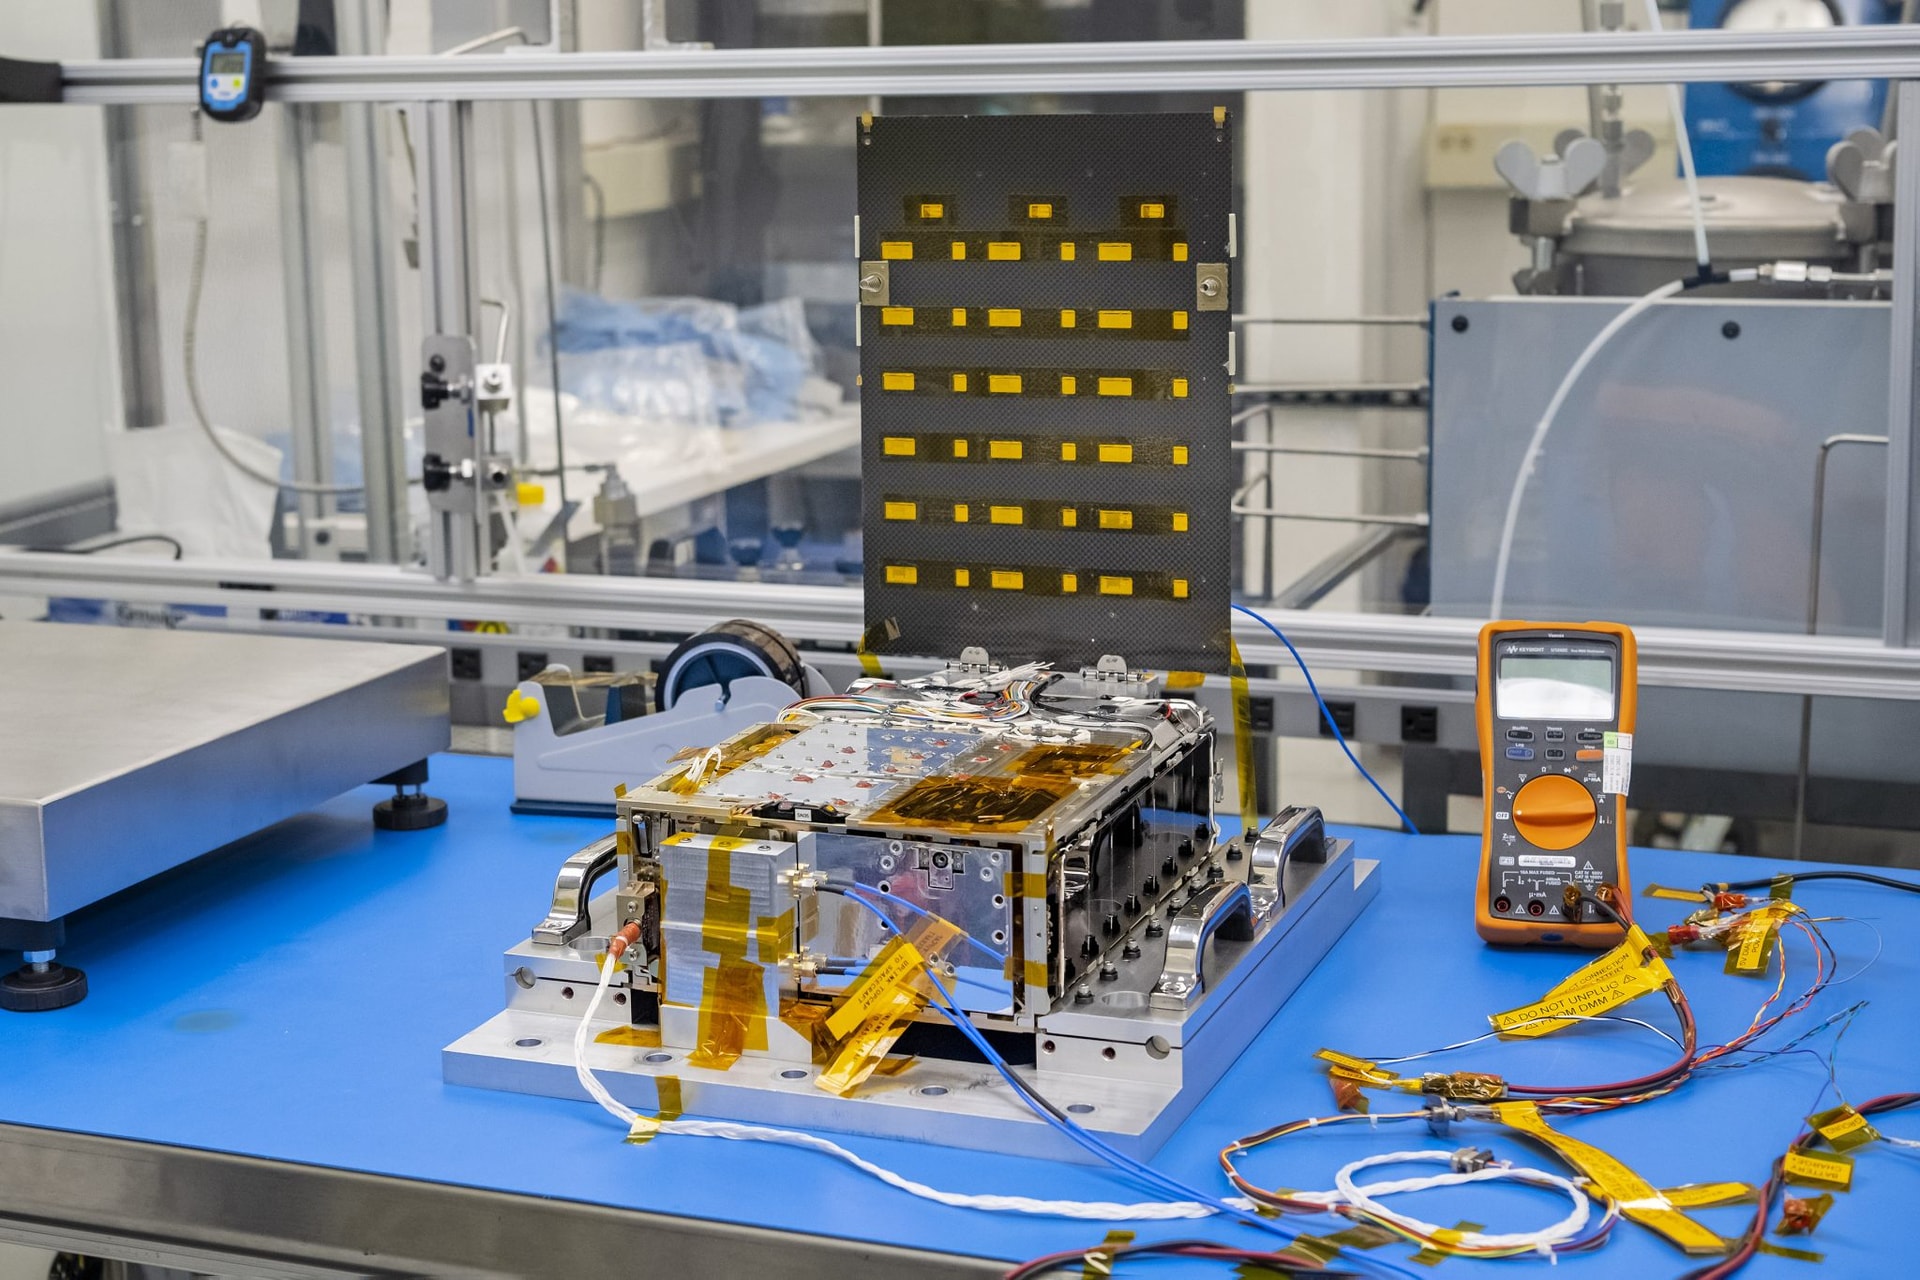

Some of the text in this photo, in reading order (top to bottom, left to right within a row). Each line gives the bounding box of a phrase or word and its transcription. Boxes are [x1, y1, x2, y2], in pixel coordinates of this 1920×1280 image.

[856, 953, 903, 1003] TO SPACECRAFT
[885, 960, 909, 984] UPLINK
[1579, 953, 1629, 985] CONNECTION
[1518, 981, 1619, 1022] DO NOT UNPLUG
[1579, 995, 1609, 1013] DMM
